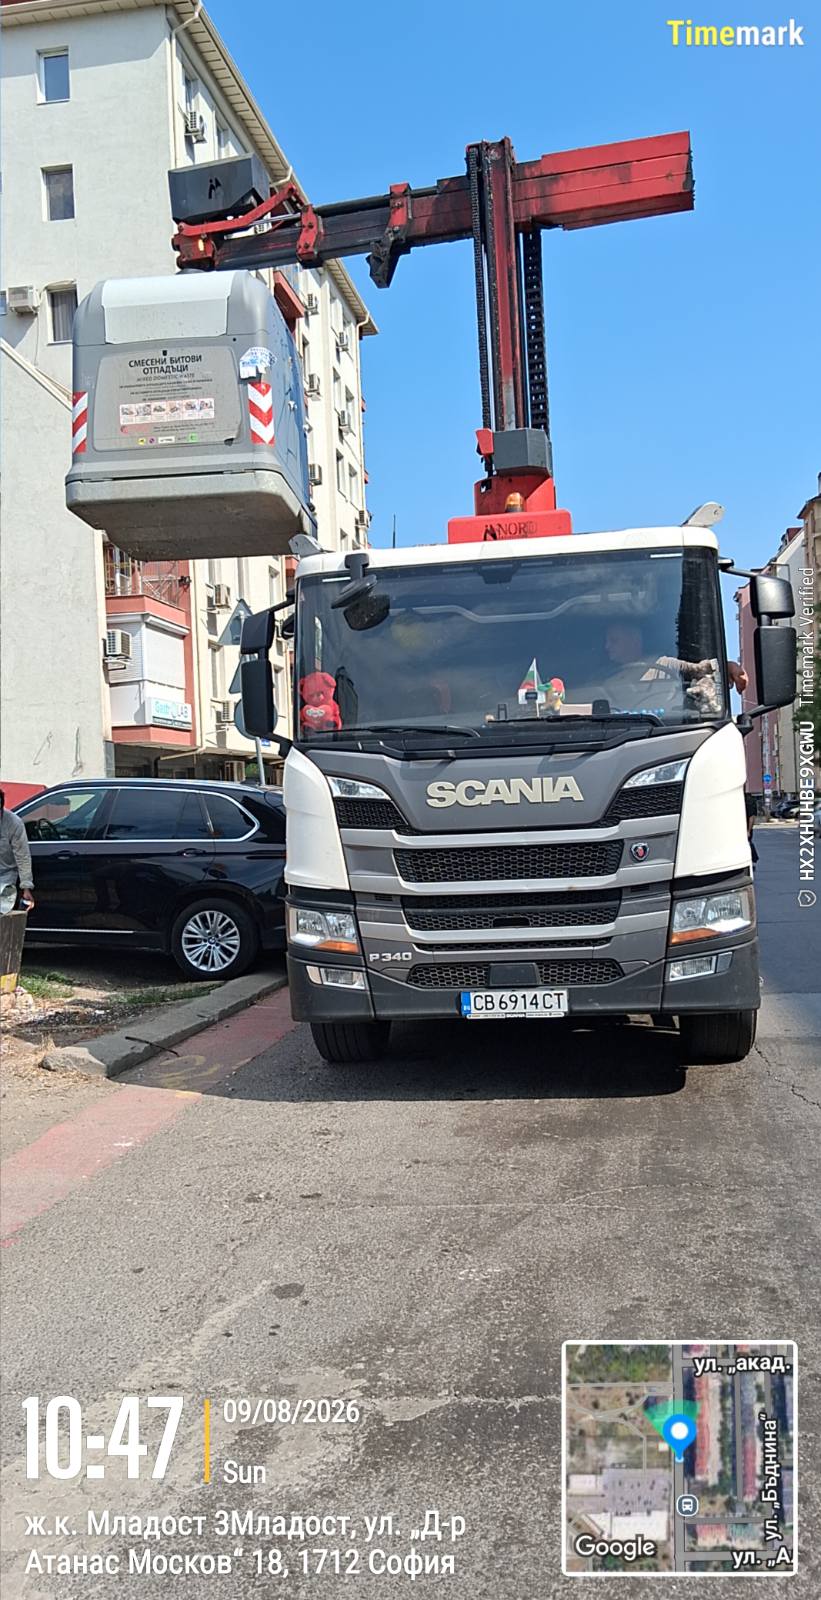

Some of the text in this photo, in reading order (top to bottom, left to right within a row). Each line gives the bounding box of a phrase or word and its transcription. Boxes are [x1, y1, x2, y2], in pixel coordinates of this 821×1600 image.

[128, 354, 202, 368] СМЕСЕНИ БИТОВИ
[142, 363, 189, 375] ОТПАДЪЦИ
[426, 776, 584, 808] SCANIA
